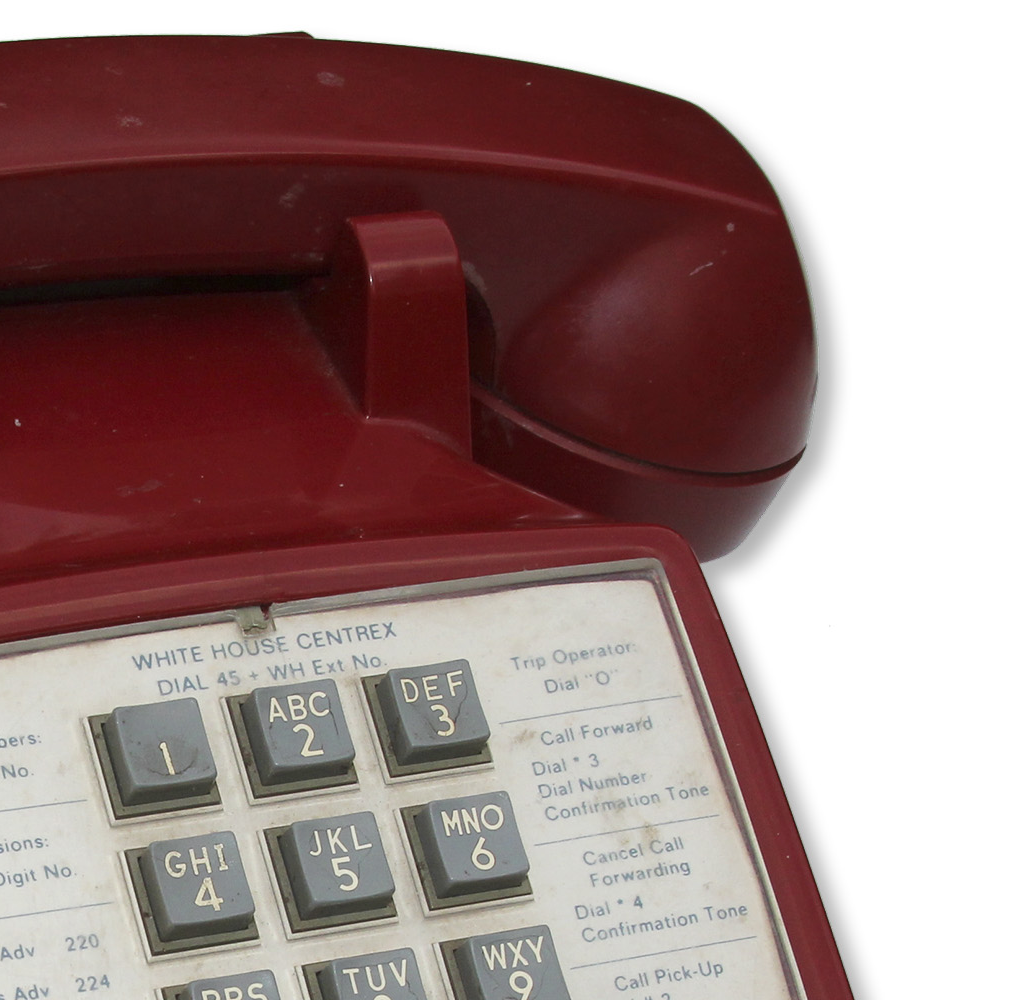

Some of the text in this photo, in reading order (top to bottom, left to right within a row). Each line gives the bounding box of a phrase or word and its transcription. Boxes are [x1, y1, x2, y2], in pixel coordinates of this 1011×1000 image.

[132, 622, 397, 671] WHITE HOUSE CENTREX
[158, 654, 386, 696] DIAL 45 + WH Ext No.
[511, 655, 545, 671] Trip
[400, 670, 463, 703] DEF
[544, 677, 579, 693] Dial
[269, 691, 329, 723] ABC
[430, 704, 454, 736] 3
[293, 724, 323, 757] 2
[541, 716, 652, 745] Call Forward
[1, 765, 34, 779] No.
[159, 742, 175, 775] 1
[532, 759, 567, 776] Dial
[589, 754, 599, 767] 3
[538, 771, 646, 798] Dial Number
[545, 785, 709, 821] Confirmation Tone
[441, 805, 504, 836] MNO
[310, 825, 372, 856] JKL
[471, 837, 495, 870] 6
[583, 837, 684, 866] Cancel Call
[45, 865, 77, 880] No.
[165, 843, 229, 878] GHI
[331, 856, 359, 891] 5
[590, 862, 690, 887] Forwarding
[194, 878, 223, 911] 4
[575, 901, 610, 920] Dial
[633, 896, 643, 909] 4
[581, 904, 748, 943] Confirmation Tone
[0, 945, 35, 962] Adv
[66, 934, 99, 952] 220
[482, 936, 543, 970] WXY
[76, 975, 110, 993] 224
[343, 960, 407, 995] TUV
[614, 962, 724, 991] Call Pick-Up
